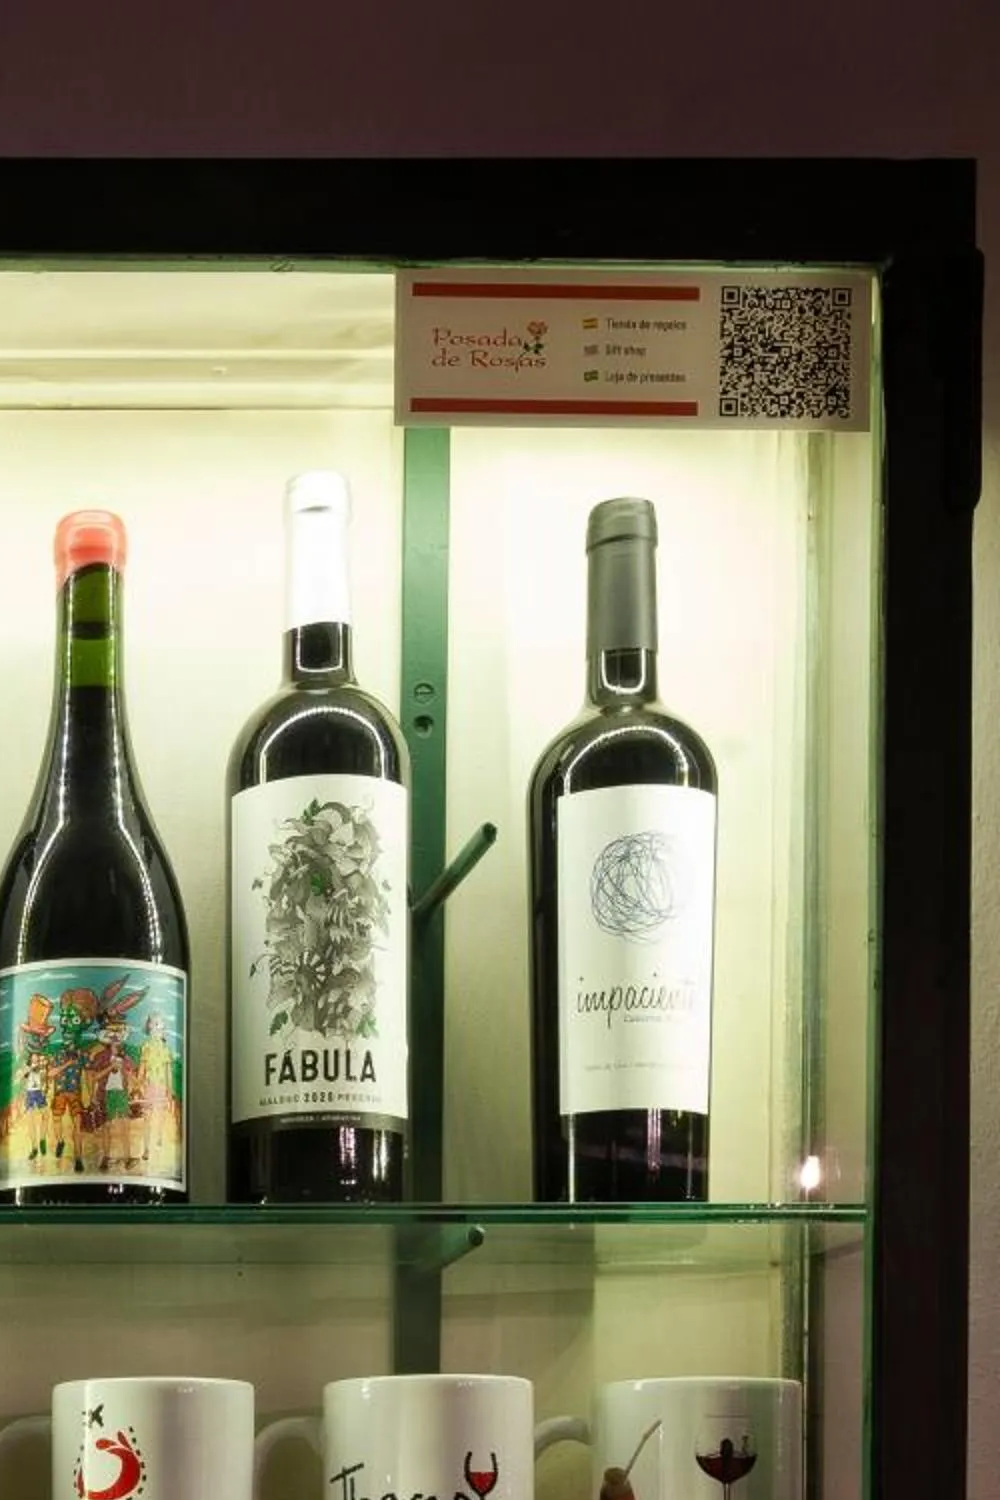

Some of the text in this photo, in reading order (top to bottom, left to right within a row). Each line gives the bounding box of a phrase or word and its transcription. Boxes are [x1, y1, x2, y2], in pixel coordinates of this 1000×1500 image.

[432, 326, 523, 347] Posada
[431, 347, 548, 372] de Rosas
[264, 1050, 377, 1086] FÁBULA
